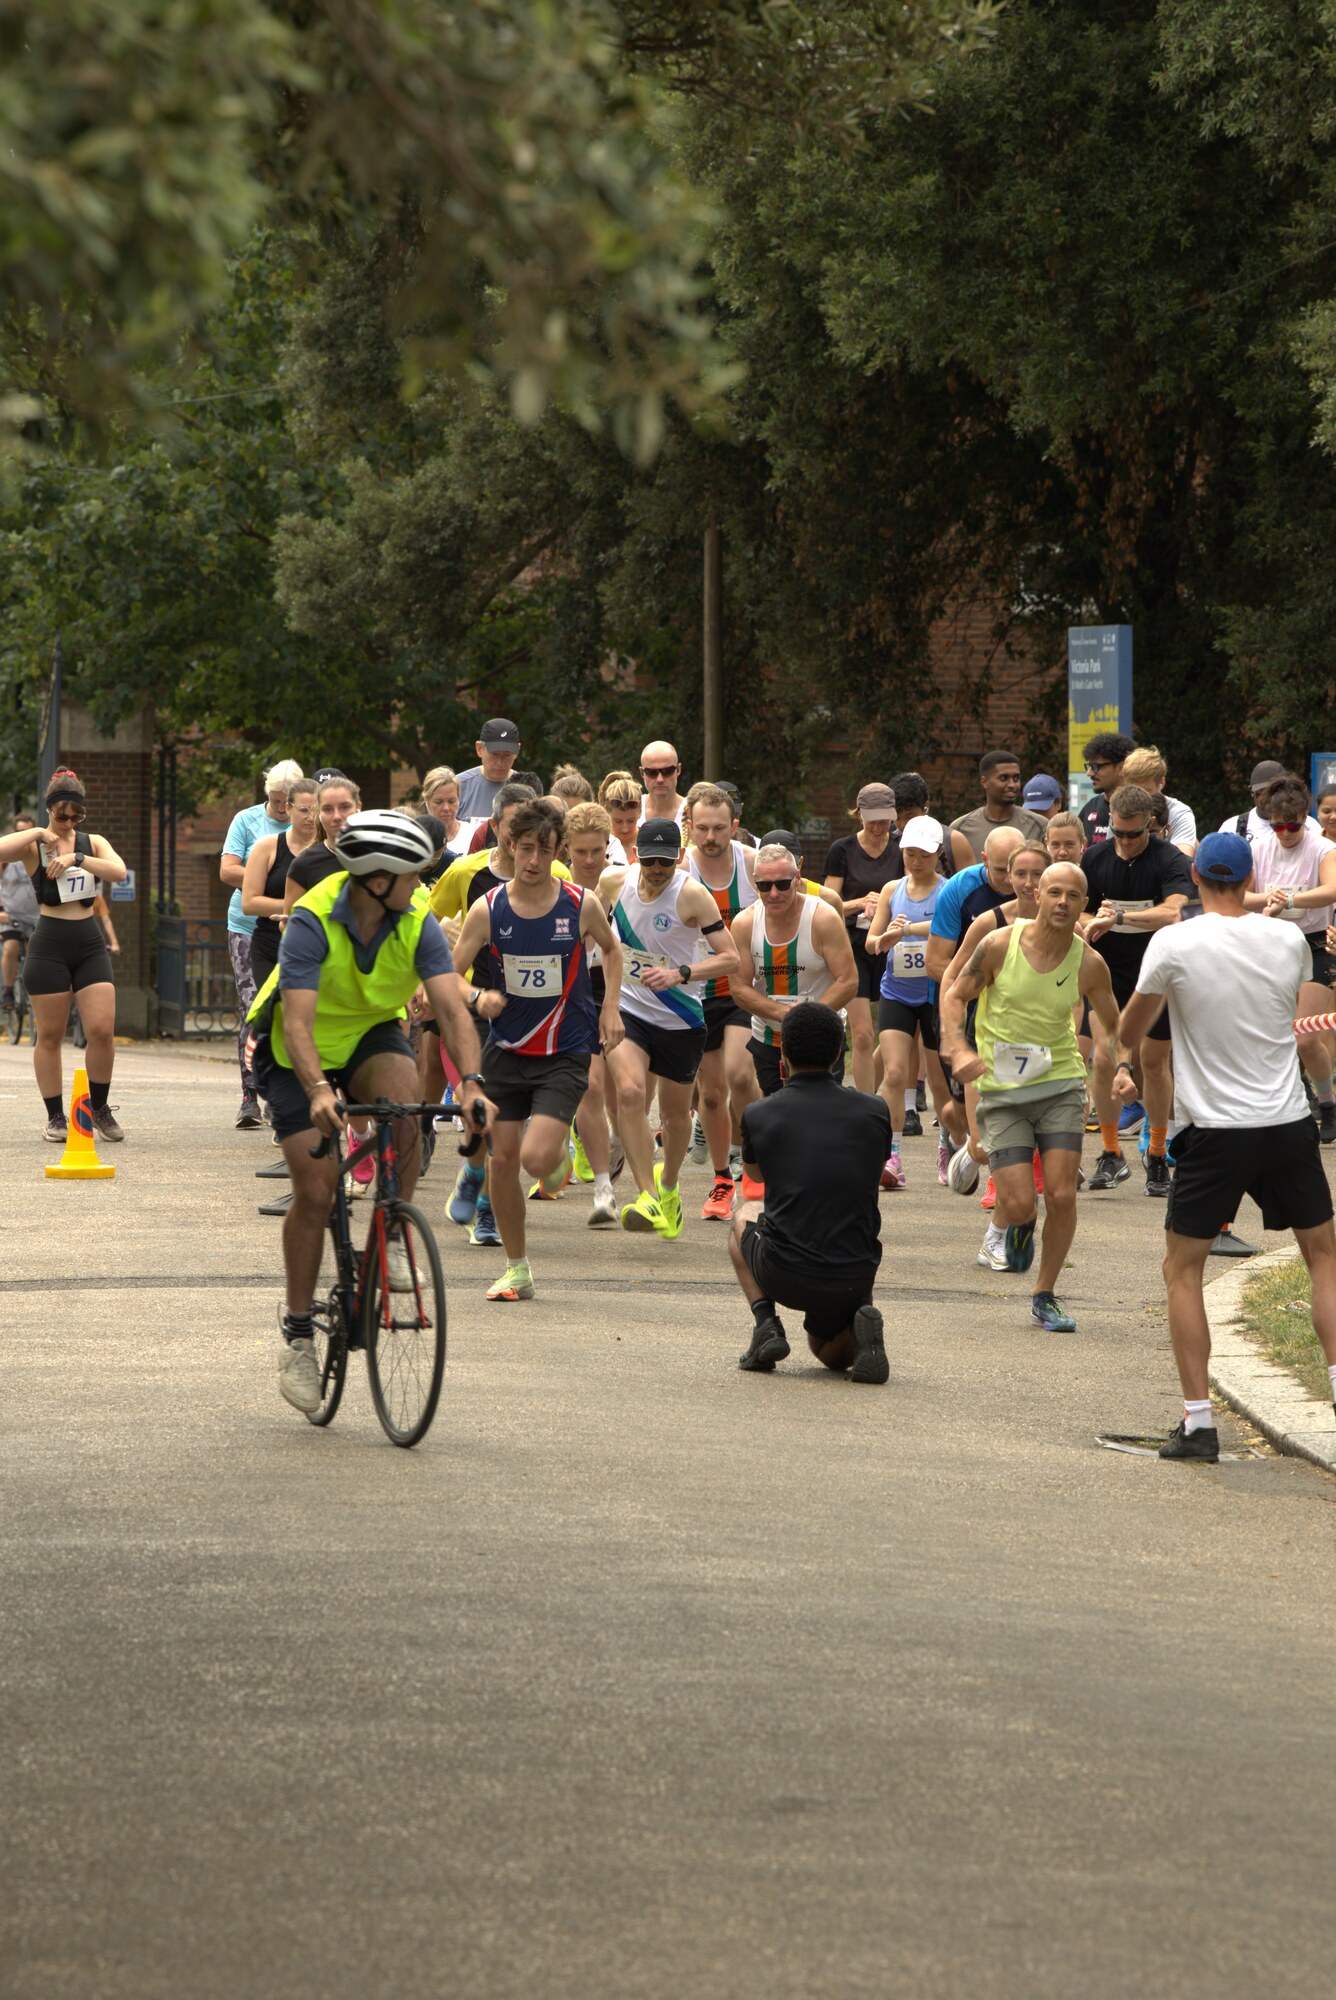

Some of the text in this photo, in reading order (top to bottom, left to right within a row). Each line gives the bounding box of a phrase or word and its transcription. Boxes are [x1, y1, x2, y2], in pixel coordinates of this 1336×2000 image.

[1071, 658, 1101, 673] Victoria Park
[67, 876, 85, 893] 77
[629, 960, 653, 979] 2
[903, 952, 926, 969] 38
[517, 969, 547, 988] 78
[1014, 1056, 1029, 1075] 7
